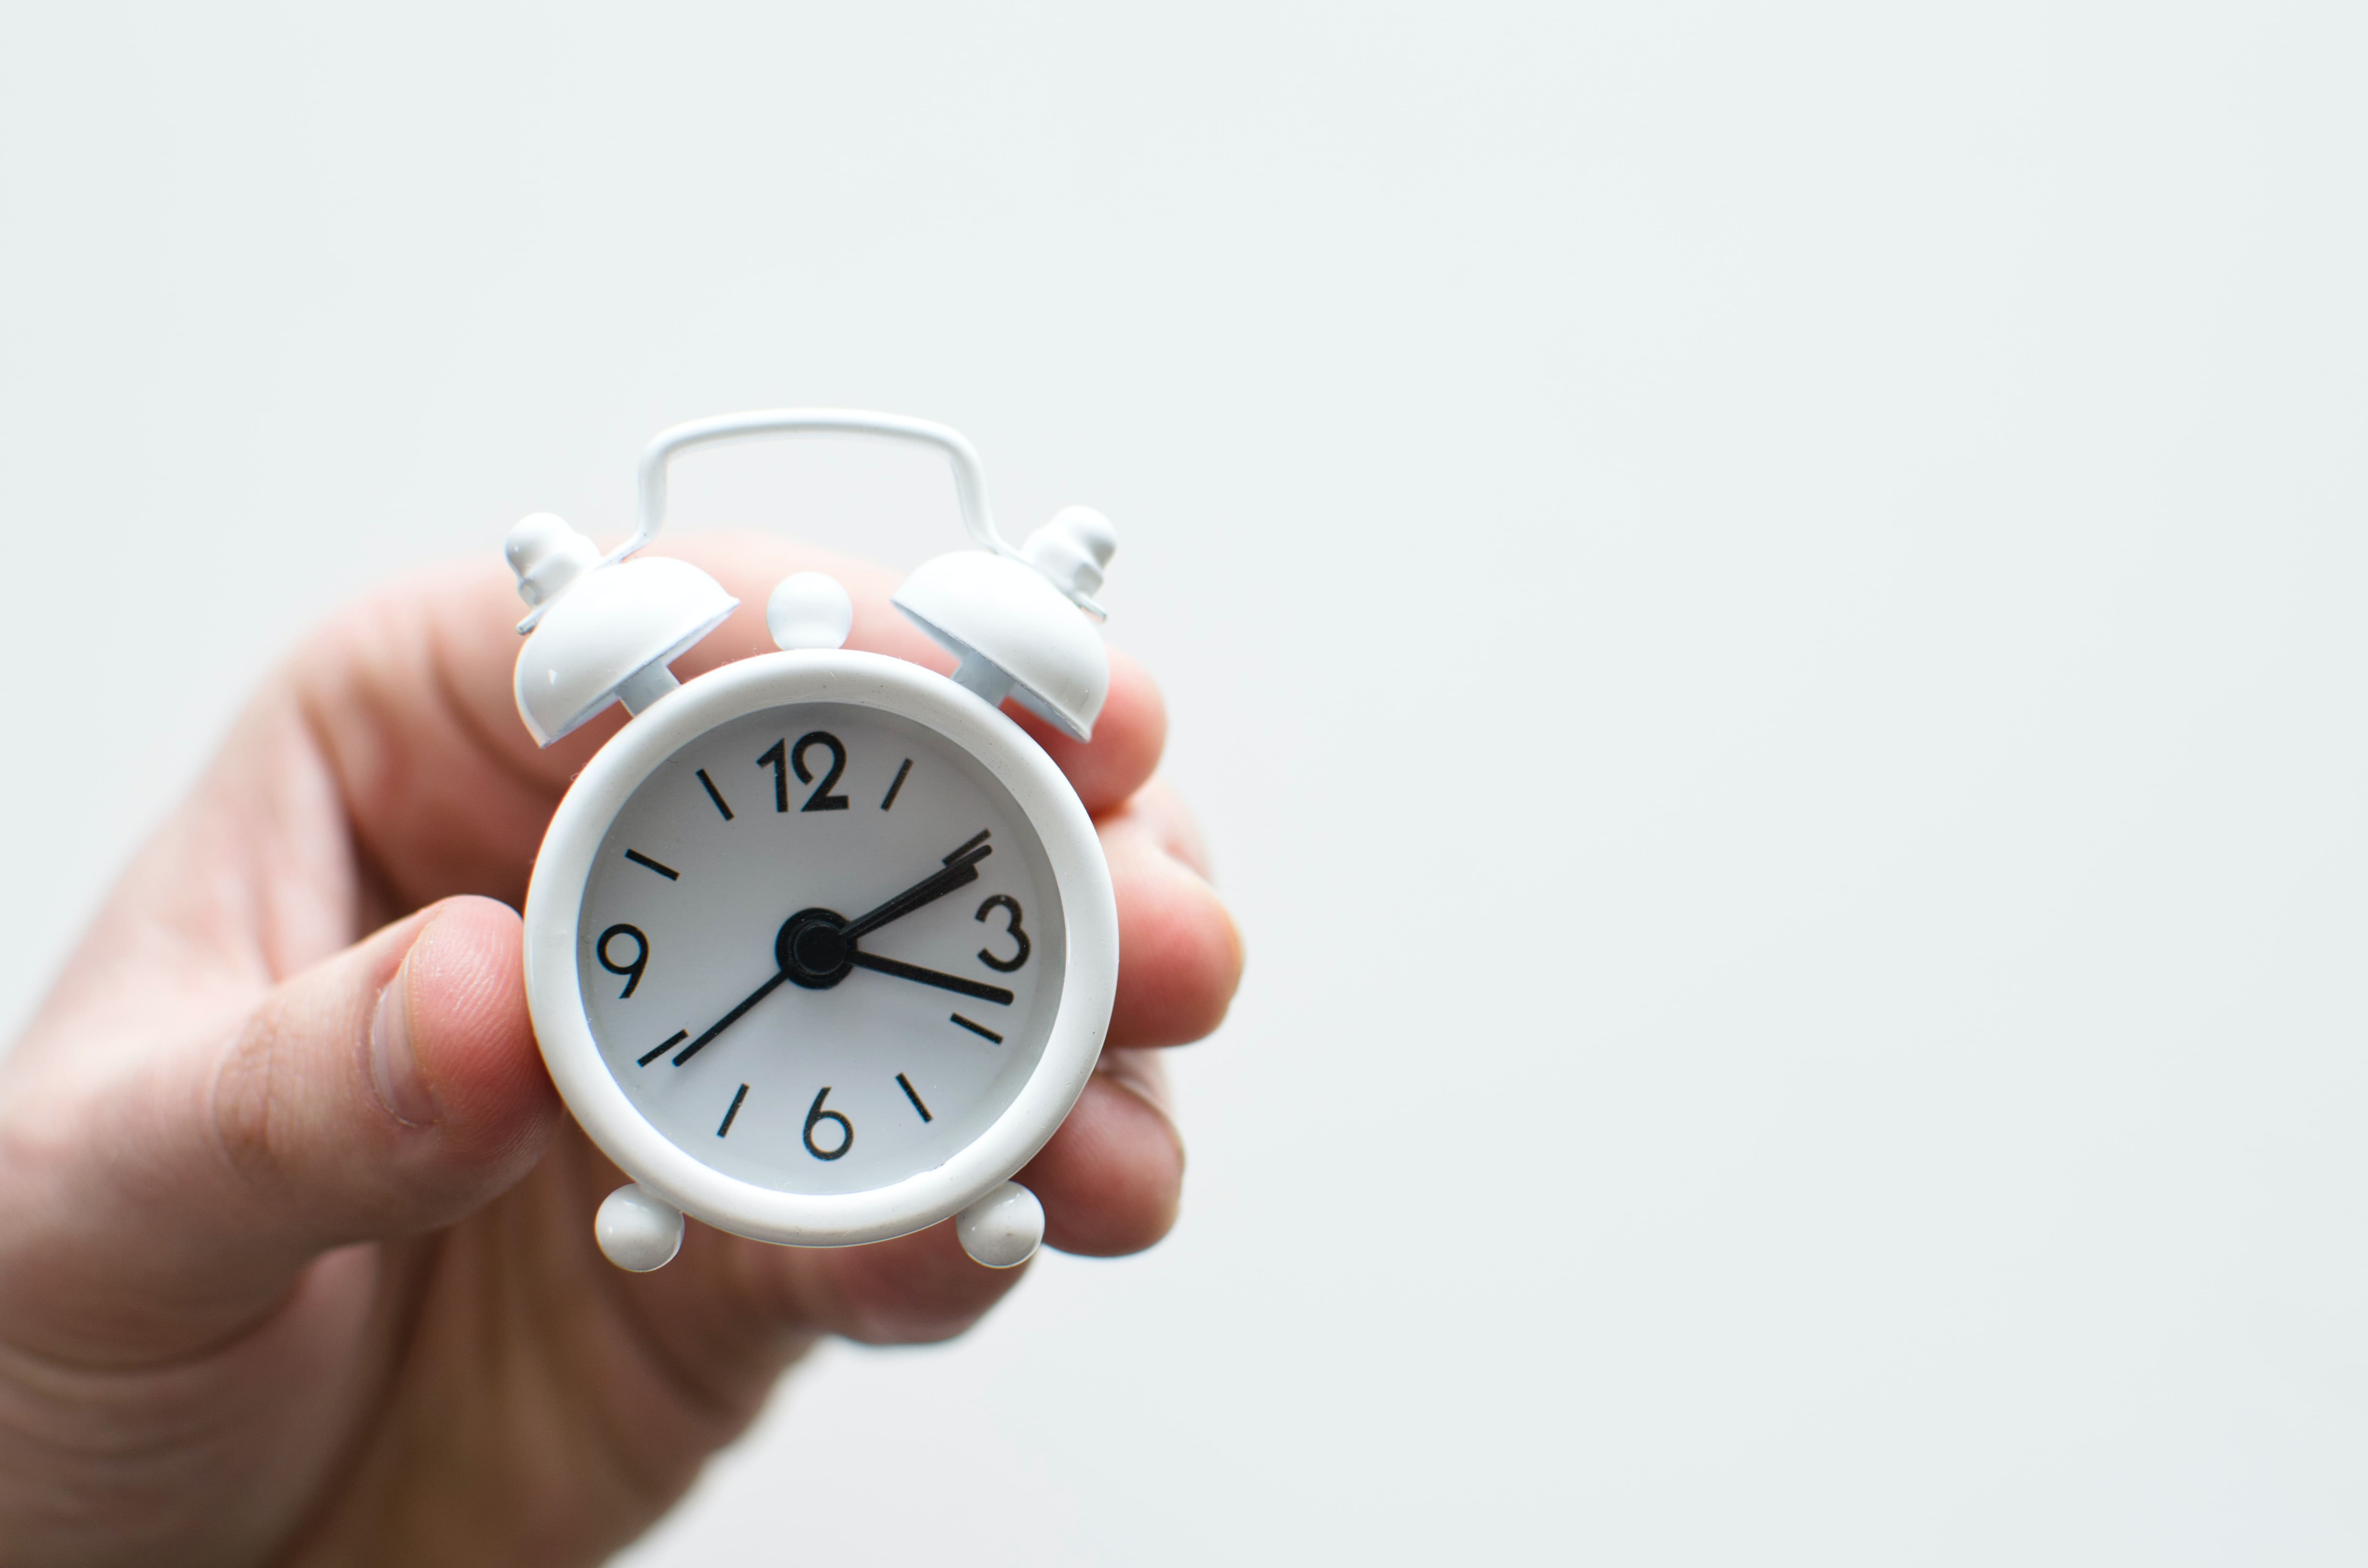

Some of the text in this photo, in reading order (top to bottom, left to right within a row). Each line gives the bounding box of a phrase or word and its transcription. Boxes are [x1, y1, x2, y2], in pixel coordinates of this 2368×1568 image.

[755, 729, 850, 813] 12
[596, 923, 649, 999] 9
[974, 894, 1031, 973] 3
[803, 1087, 853, 1161] 6
